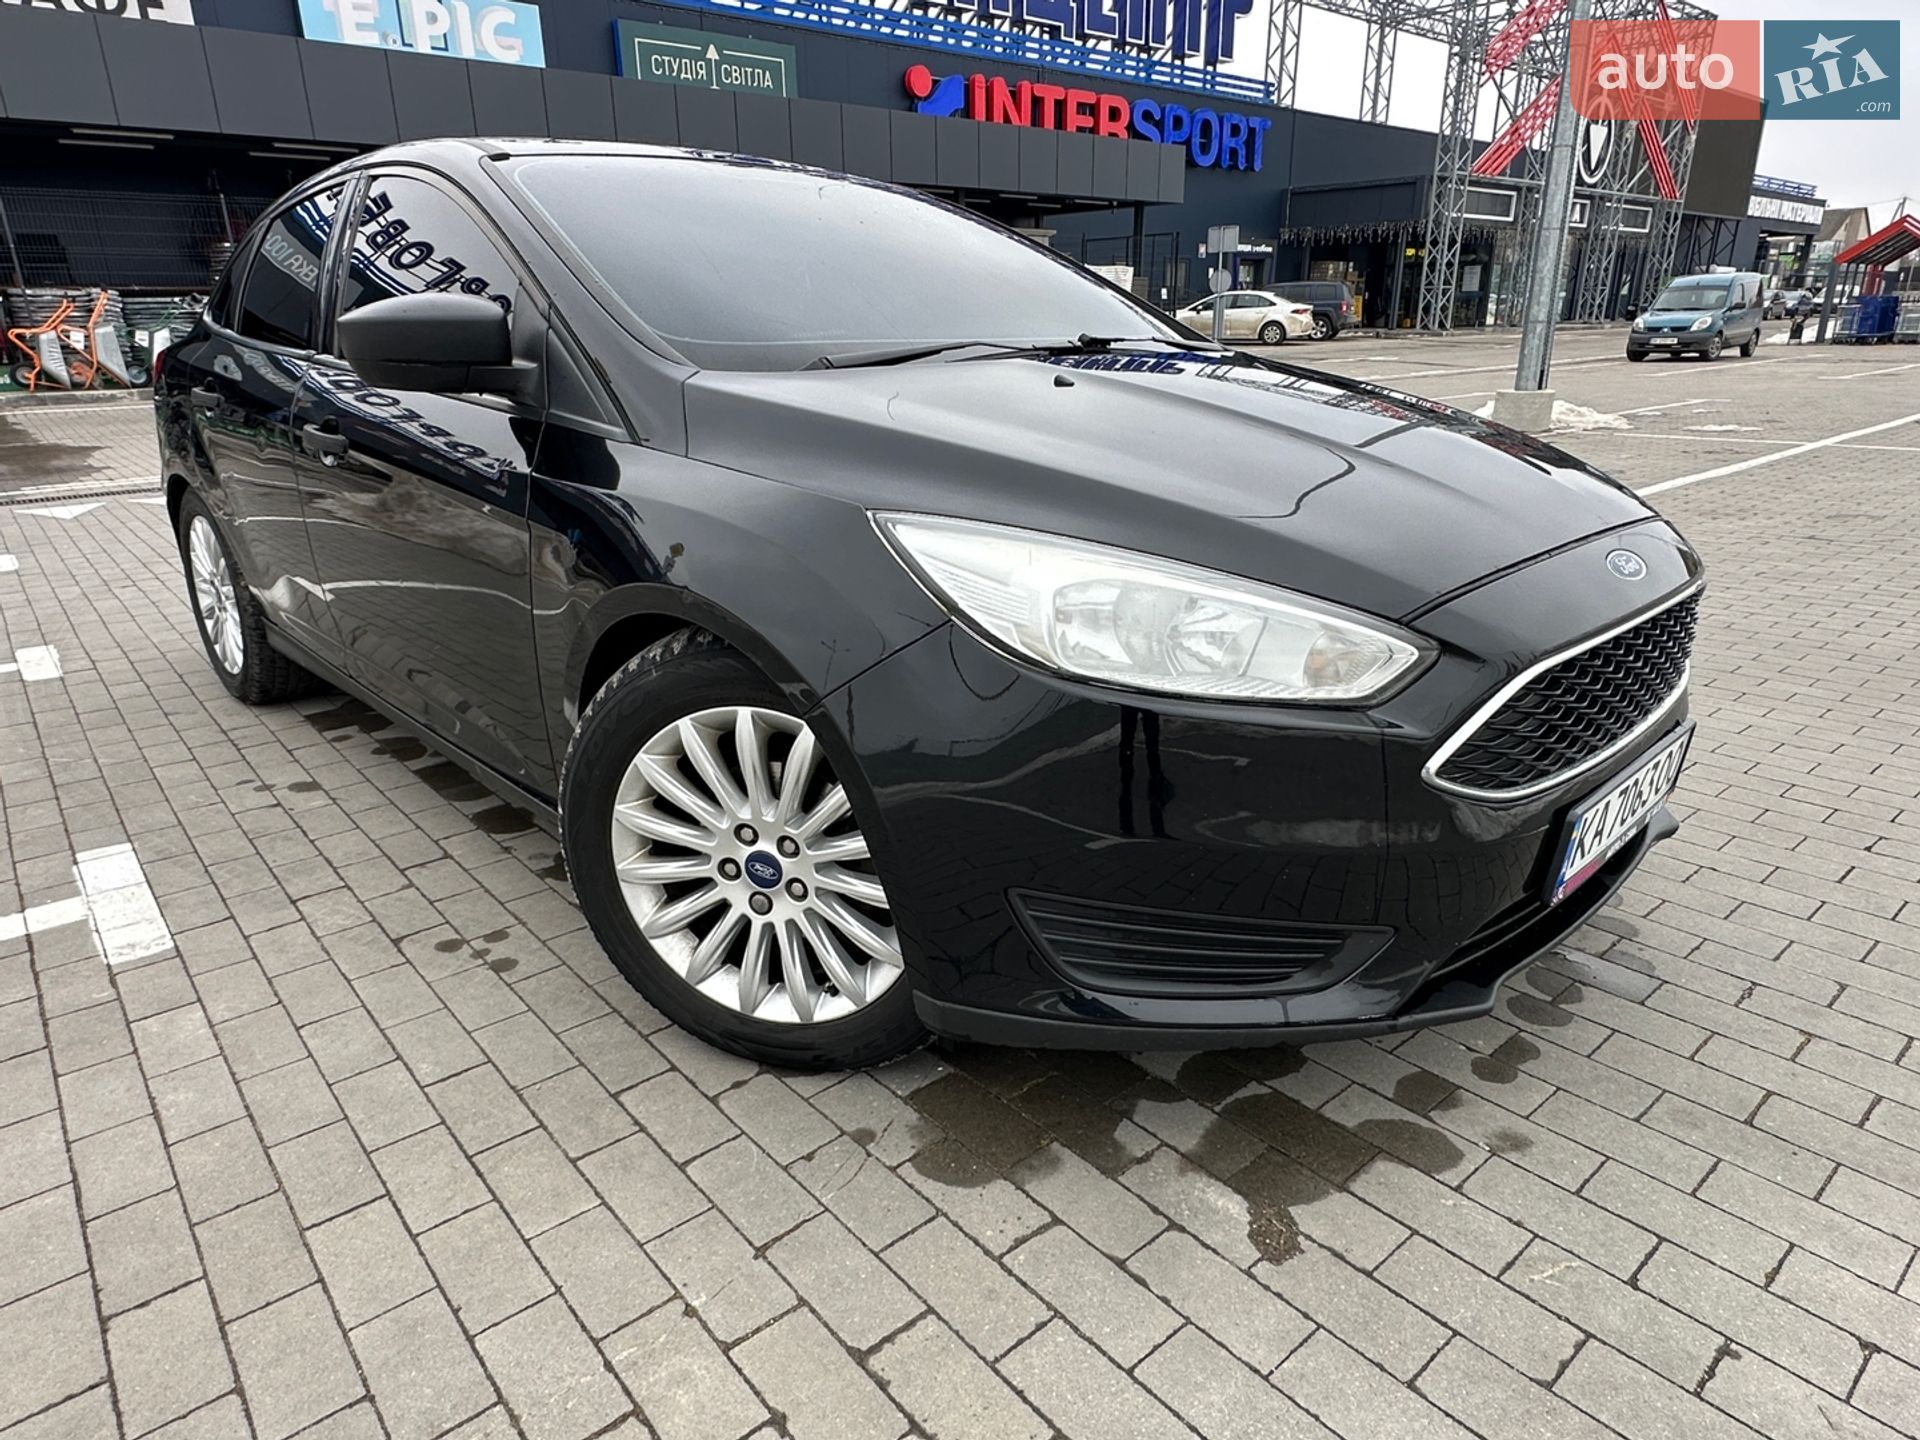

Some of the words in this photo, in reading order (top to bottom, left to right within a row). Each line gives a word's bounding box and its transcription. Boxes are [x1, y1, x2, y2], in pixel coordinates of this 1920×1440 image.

[651, 54, 706, 81] СТУДІЯ
[721, 64, 773, 89] СВІТЛА
[969, 73, 1272, 172] INTERSPORT
[1570, 799, 1612, 870] KA
[1607, 759, 1661, 840] 7063
